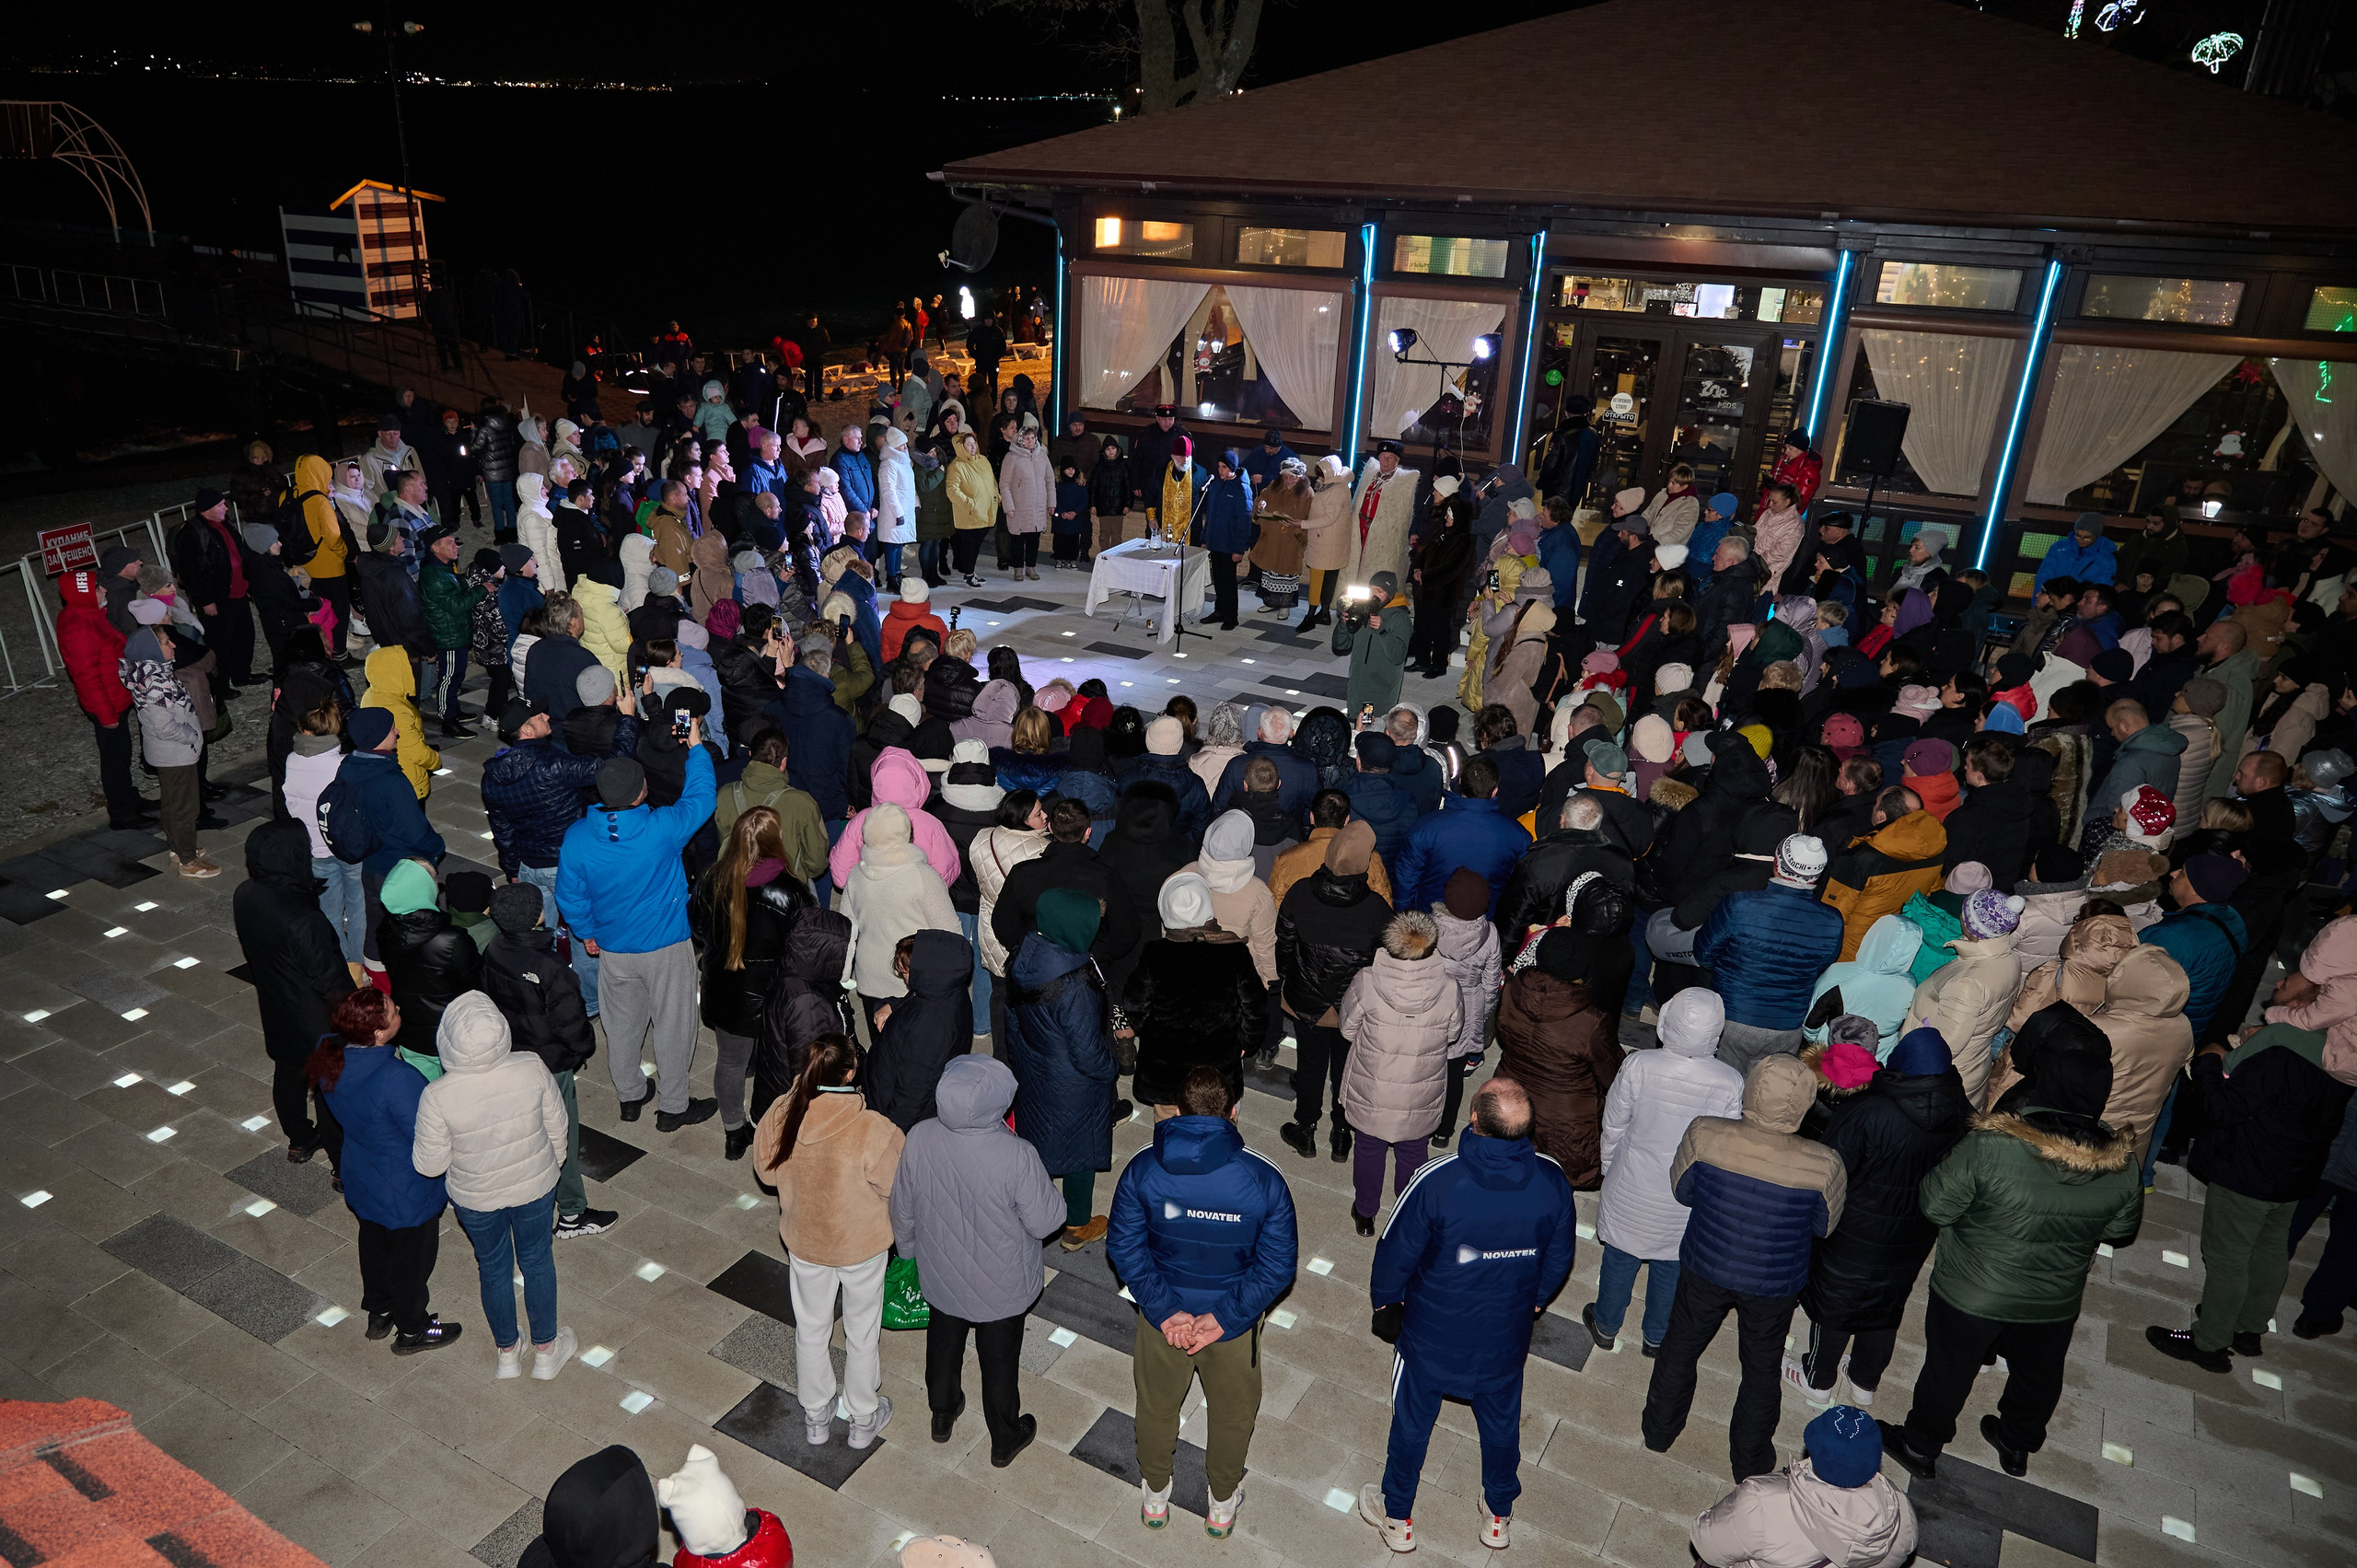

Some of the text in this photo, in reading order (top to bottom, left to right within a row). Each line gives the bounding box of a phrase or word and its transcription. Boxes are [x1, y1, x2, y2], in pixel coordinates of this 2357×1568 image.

[46, 530, 88, 548] КУПАНИЕ
[1788, 857, 1807, 871] SOCHI
[1187, 1209, 1241, 1222] NOVATEK
[1482, 1249, 1537, 1260] NOVATEK
